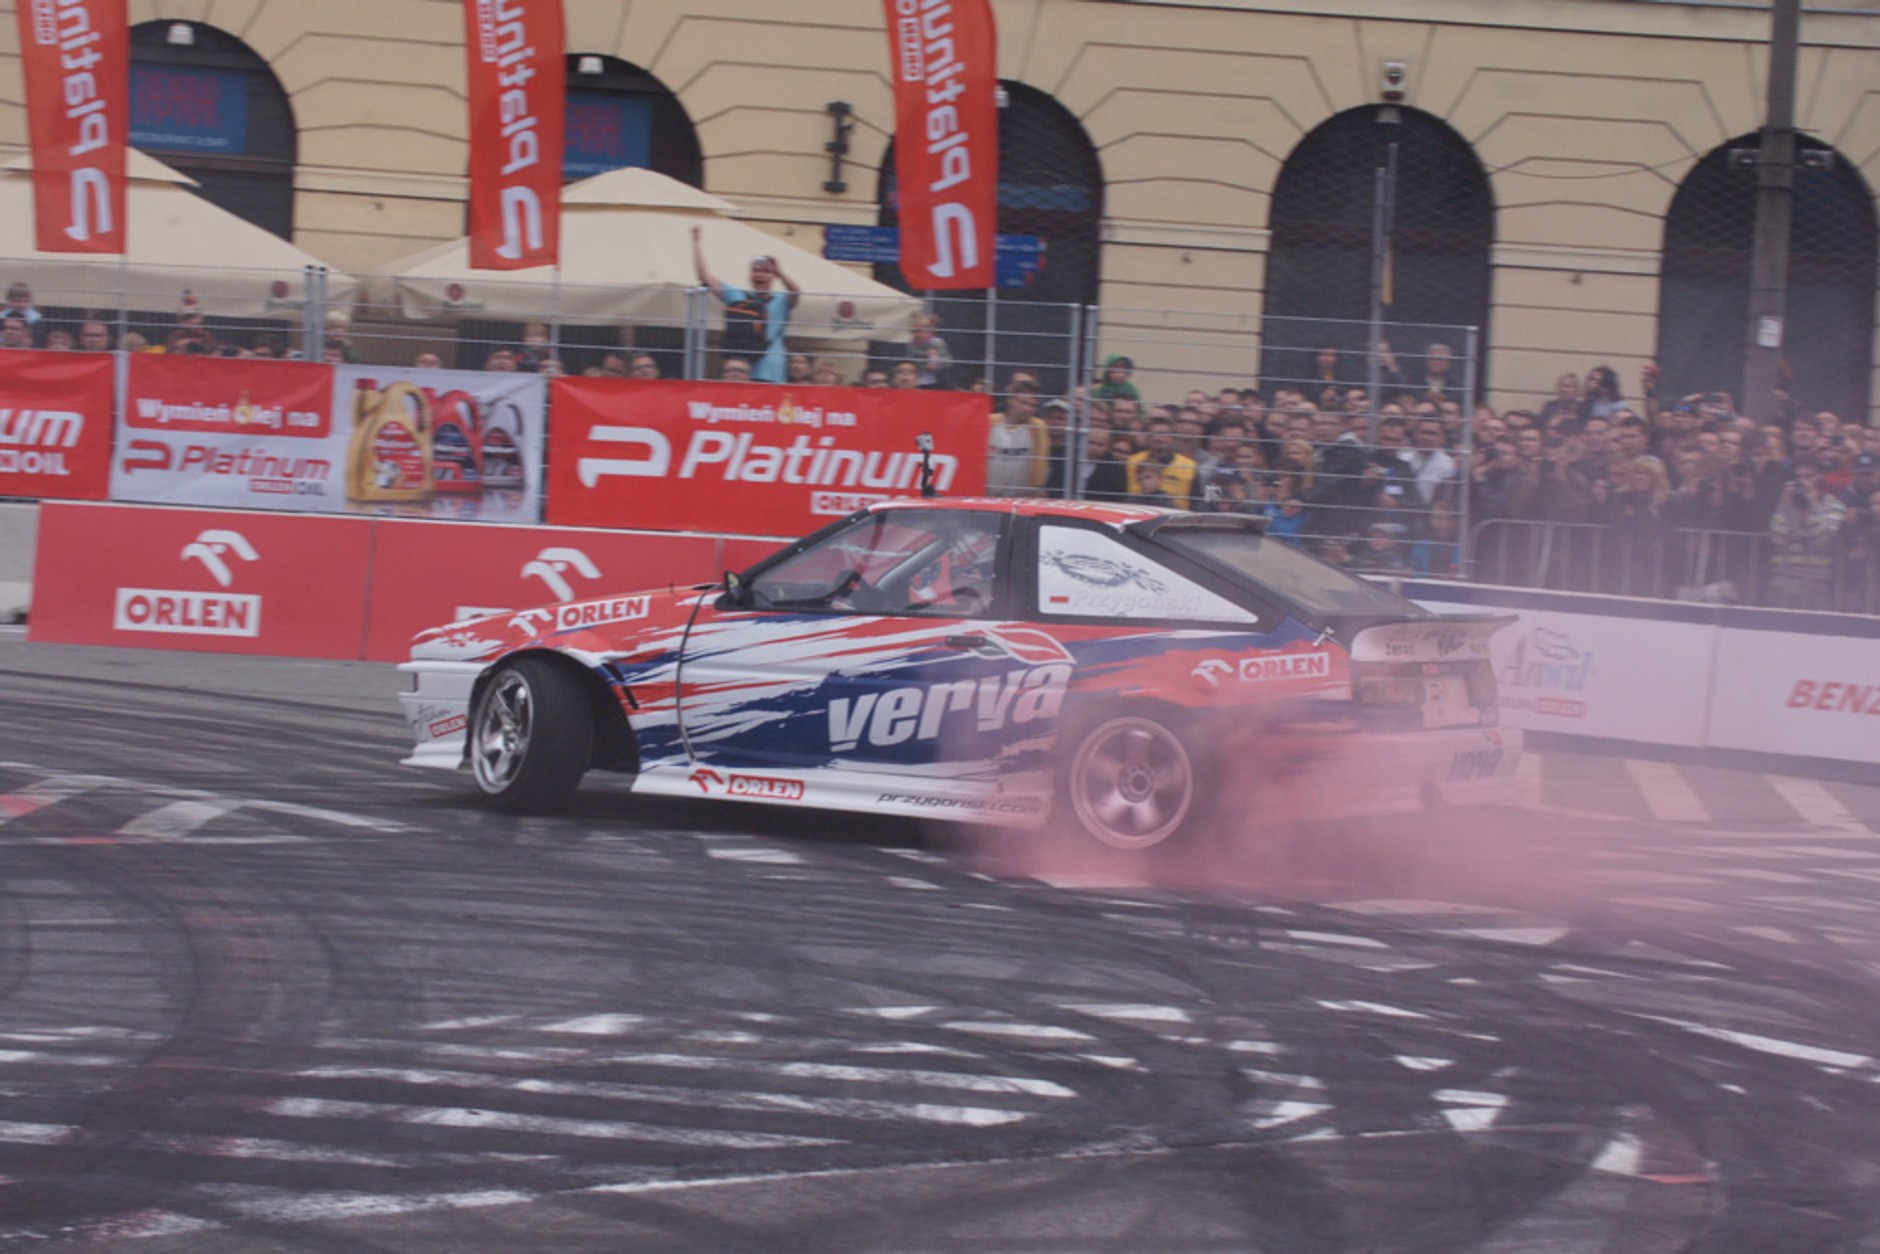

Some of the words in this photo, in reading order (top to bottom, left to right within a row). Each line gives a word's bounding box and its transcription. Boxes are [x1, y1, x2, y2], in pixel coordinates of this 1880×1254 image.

[177, 445, 331, 480] Platinum
[678, 429, 958, 491] Platinum
[126, 595, 248, 629] ORLEN
[562, 598, 643, 627] ORLEN
[1241, 656, 1325, 680] ORLEN
[828, 663, 1073, 752] verva
[732, 777, 801, 798] ORLEN
